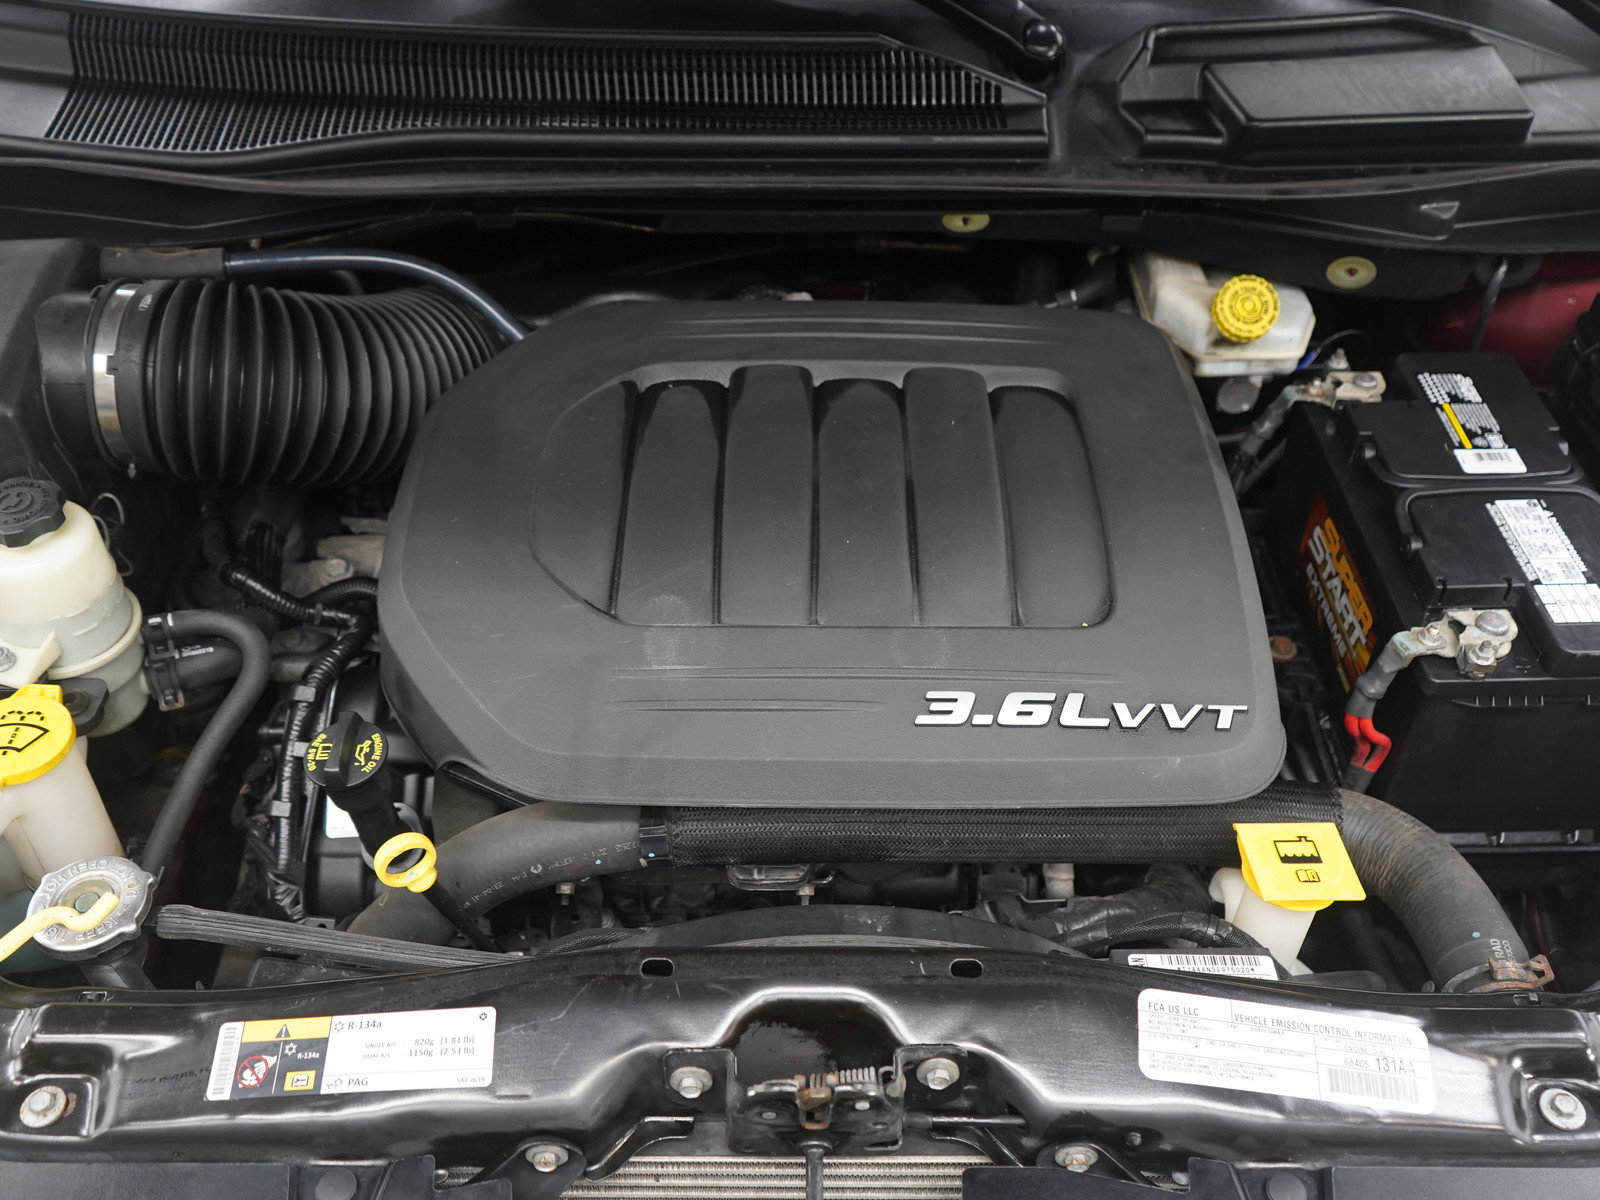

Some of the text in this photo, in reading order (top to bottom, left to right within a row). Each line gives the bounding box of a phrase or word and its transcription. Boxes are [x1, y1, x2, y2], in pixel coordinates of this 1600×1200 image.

[1308, 525, 1366, 646] START
[1321, 517, 1373, 635] SUPER
[1306, 562, 1347, 658] EXTREME
[360, 733, 384, 773] ENGINE OIL
[69, 860, 109, 877] OPEN
[1489, 938, 1506, 959] RAD
[1148, 1002, 1199, 1017] FCA US LLC
[347, 1019, 382, 1030] R-134a
[1234, 1014, 1269, 1027] VEHICLE
[1271, 1018, 1311, 1032] EMISSION
[1313, 1024, 1351, 1038] CONTROL
[1354, 1030, 1412, 1046] INFORMATION
[408, 1048, 434, 1058] 1150g
[439, 1047, 462, 1057] (2.53
[463, 1046, 475, 1056] lb)
[414, 1038, 434, 1048] 820g
[440, 1036, 462, 1046] (1.81
[463, 1035, 475, 1045] lb)
[1375, 1056, 1416, 1077] 131AA
[347, 1077, 369, 1087] PAG
